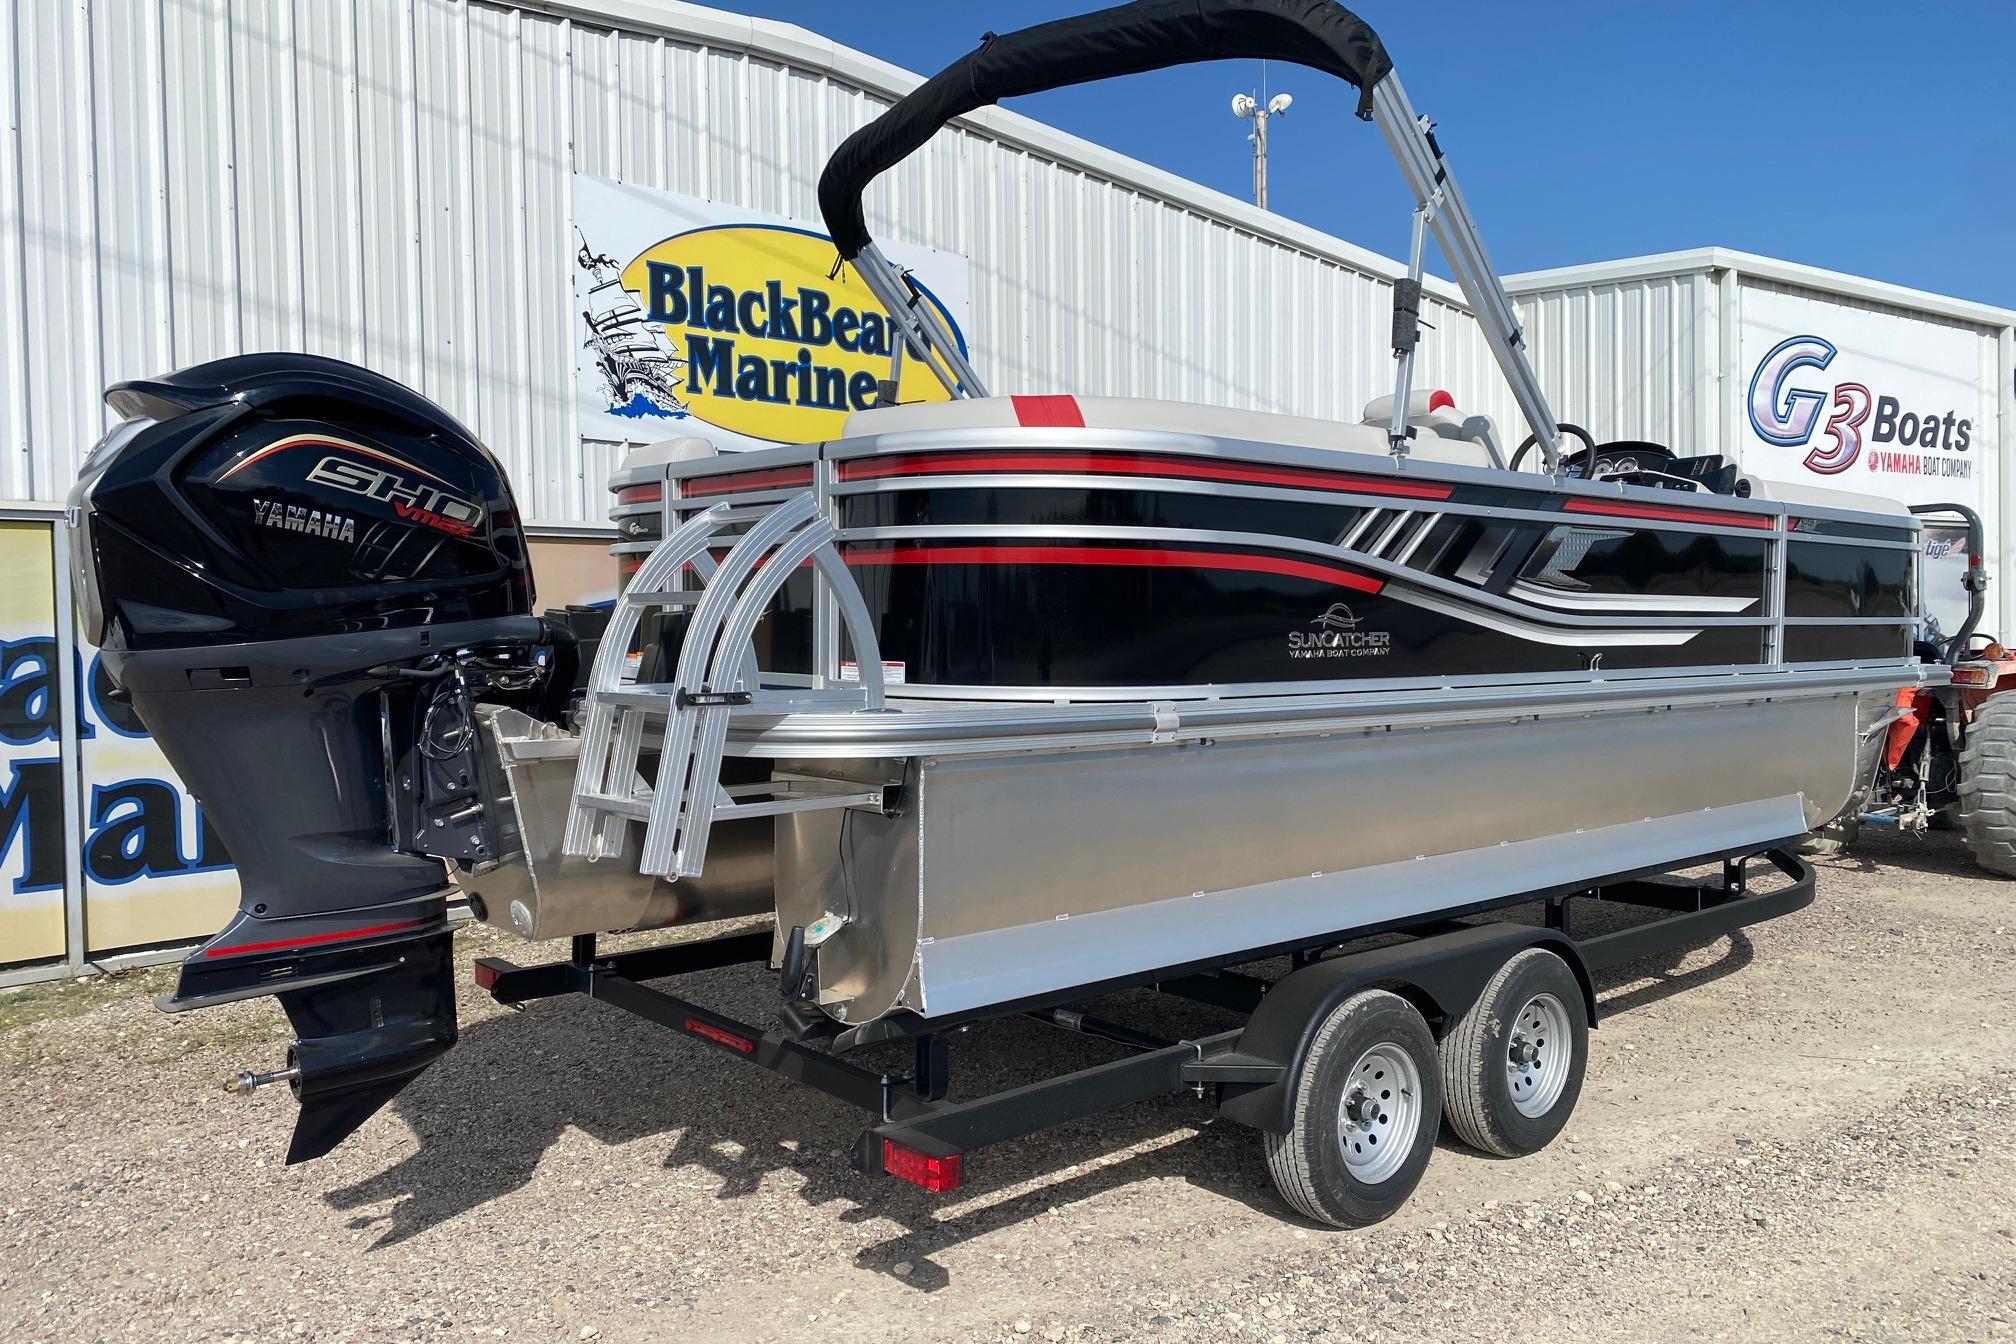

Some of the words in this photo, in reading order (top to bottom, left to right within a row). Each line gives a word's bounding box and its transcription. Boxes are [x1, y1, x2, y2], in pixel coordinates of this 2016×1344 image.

[685, 334, 879, 412] Marine
[1747, 335, 1872, 475] G3
[1871, 395, 1973, 451] Boats
[305, 456, 484, 527] SHO
[1880, 451, 1921, 475] YAMAHA
[1923, 456, 1940, 476] BOAT
[1941, 457, 1972, 480] COMPANY
[253, 499, 355, 544] YAMAHA
[1289, 649, 1325, 659] YAMAHA
[1326, 649, 1350, 658] BOAT
[1350, 647, 1391, 657] COMPANY
